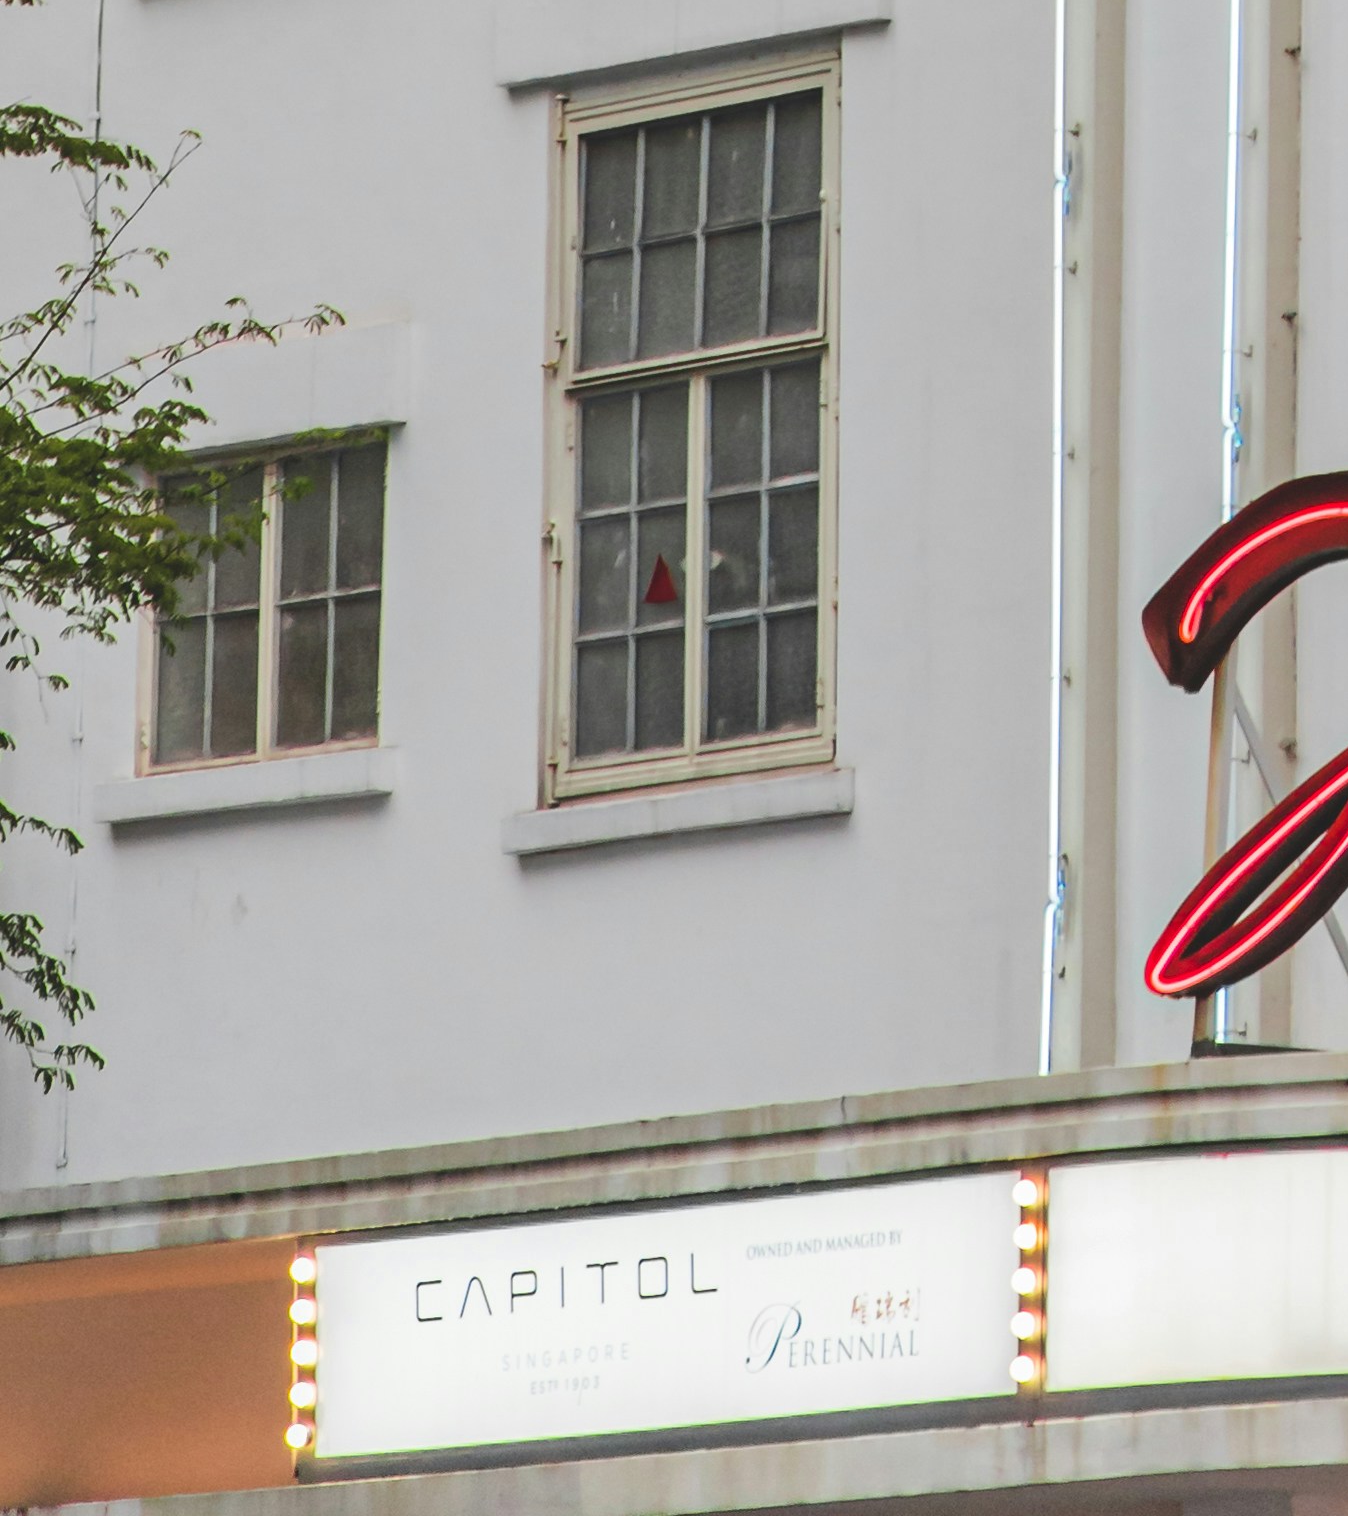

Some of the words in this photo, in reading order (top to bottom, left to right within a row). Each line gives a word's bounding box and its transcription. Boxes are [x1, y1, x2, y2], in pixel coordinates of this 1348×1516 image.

[745, 1241, 793, 1261] OWNED
[795, 1238, 822, 1255] AND
[825, 1231, 886, 1252] MANAGED
[889, 1228, 904, 1245] BY
[415, 1252, 719, 1323] CAPITOL
[502, 1341, 631, 1372] SINGAPORE
[565, 1375, 601, 1392] 1903
